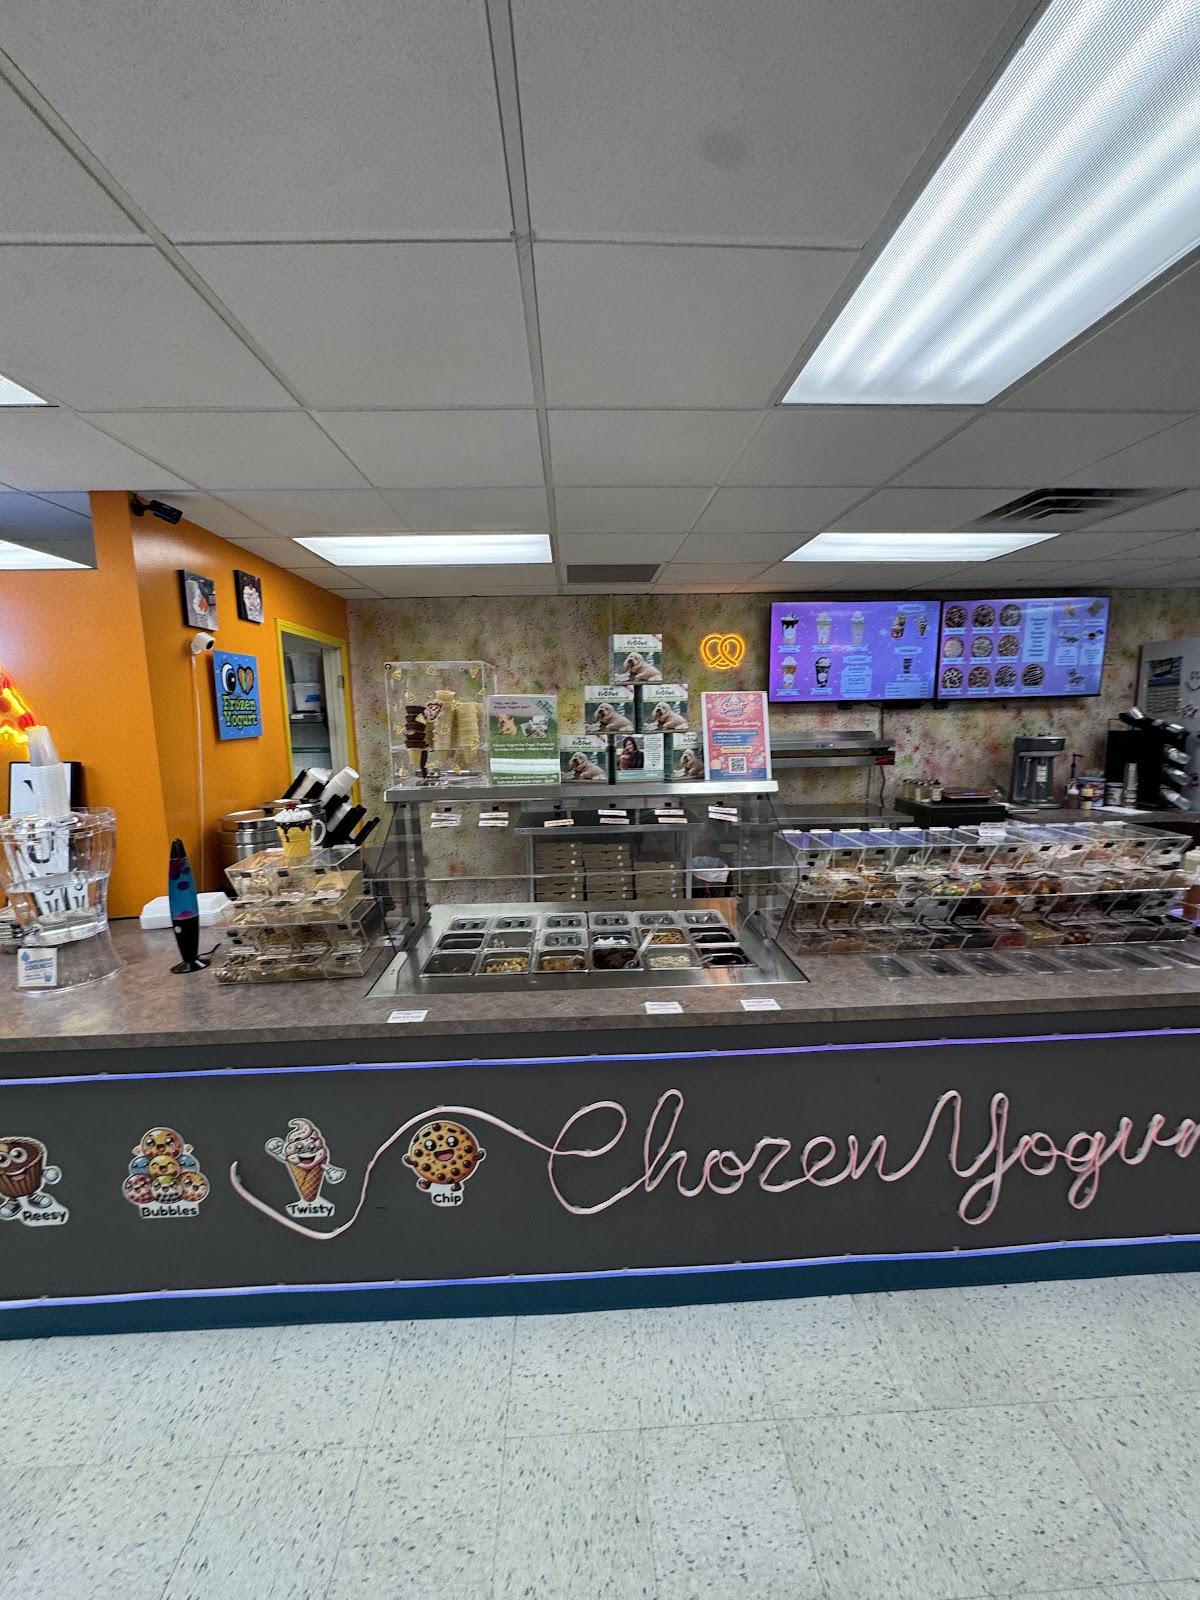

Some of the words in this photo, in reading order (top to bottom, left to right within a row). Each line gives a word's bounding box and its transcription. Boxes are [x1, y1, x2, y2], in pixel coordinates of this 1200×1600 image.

[222, 695, 257, 711] Frozen
[223, 711, 258, 730] Yogurt
[547, 1088, 905, 1215] Chozen
[431, 1192, 463, 1207] Chip
[22, 1209, 67, 1223] Reesy
[141, 1206, 198, 1217] Bubbles
[287, 1202, 335, 1218] Twisty
